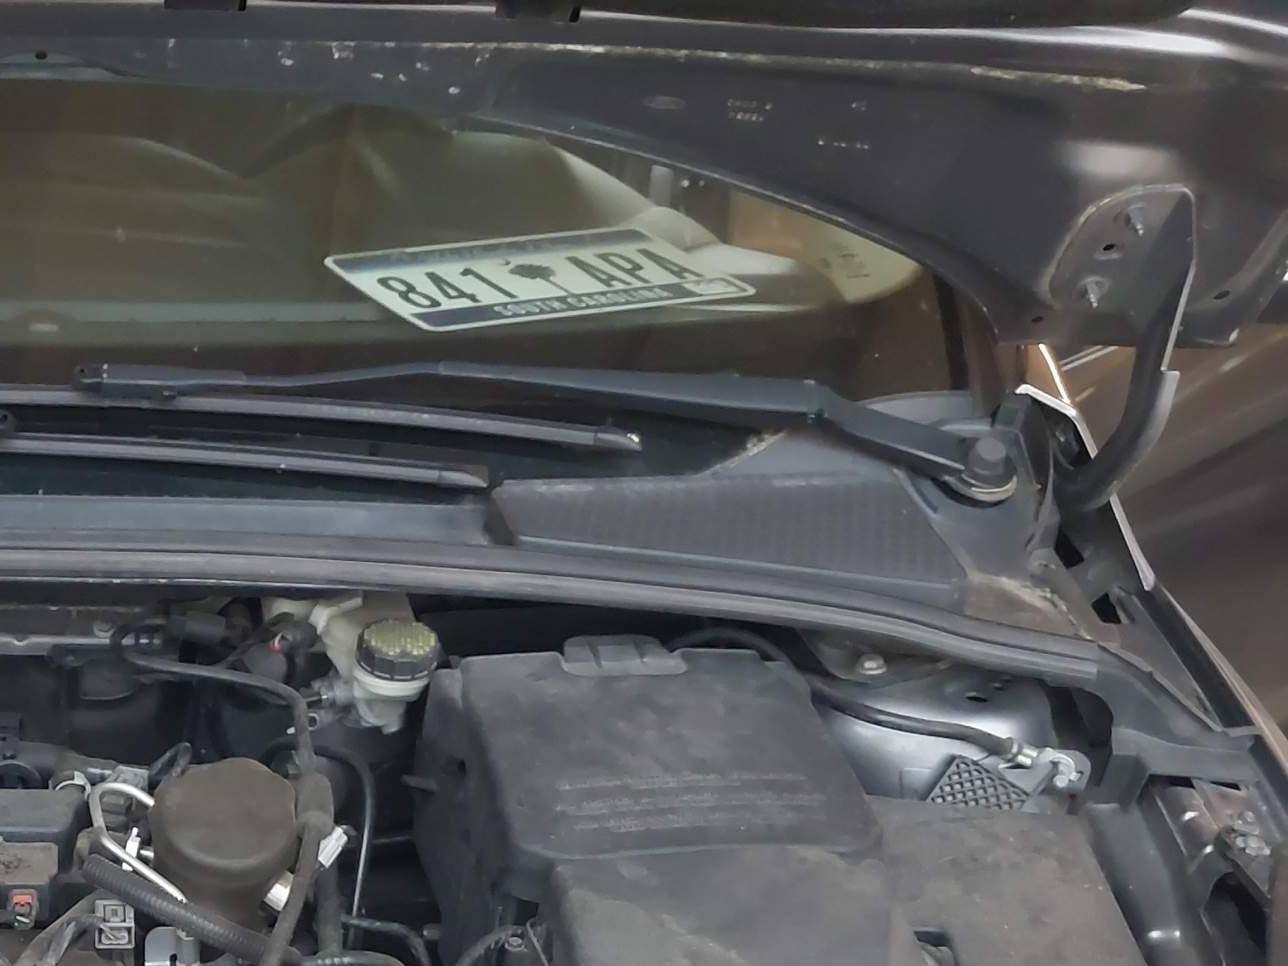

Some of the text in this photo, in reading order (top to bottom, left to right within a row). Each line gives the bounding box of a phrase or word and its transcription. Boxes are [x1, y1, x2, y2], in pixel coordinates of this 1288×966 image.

[376, 266, 519, 310] 841
[565, 247, 705, 290] APA
[492, 297, 569, 316] SOUTH
[566, 286, 674, 308] CAROLINA
